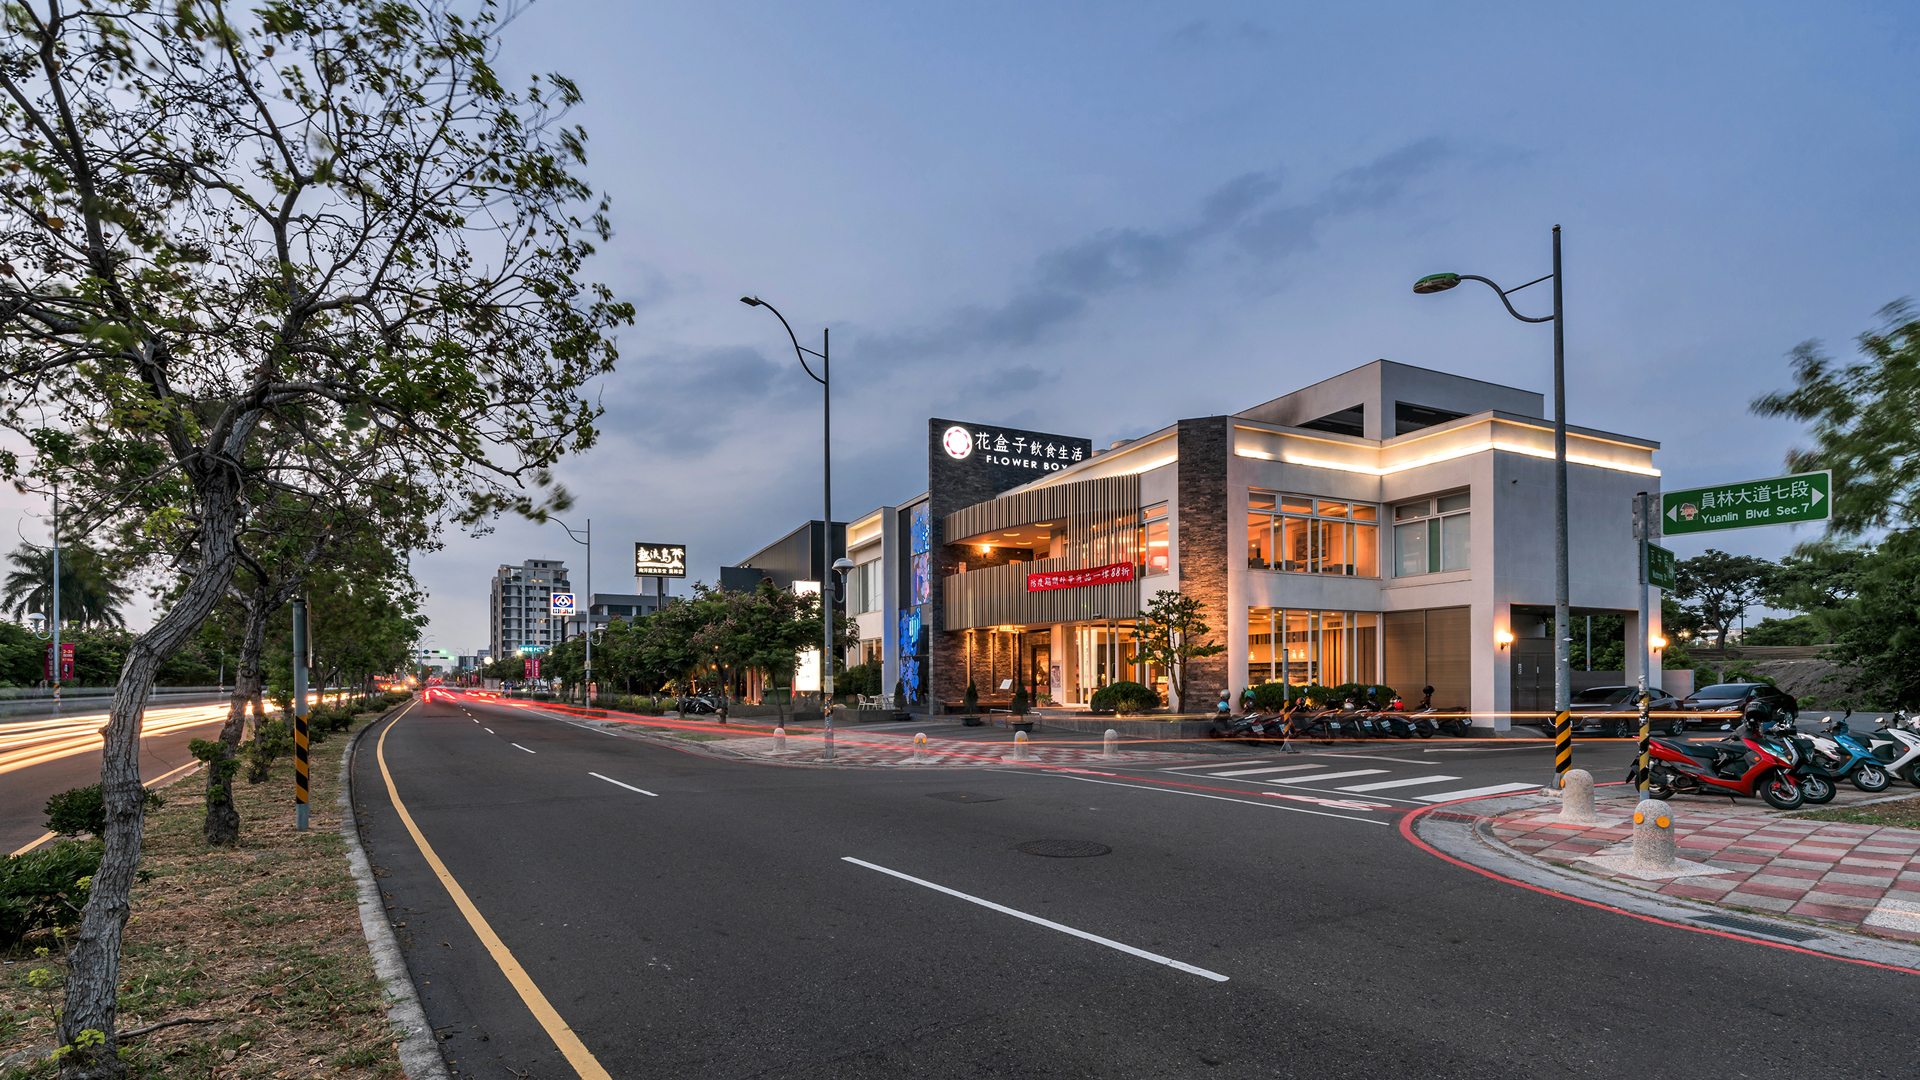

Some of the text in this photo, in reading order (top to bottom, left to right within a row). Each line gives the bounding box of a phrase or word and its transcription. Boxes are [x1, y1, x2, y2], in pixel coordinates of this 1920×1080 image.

[974, 432, 1083, 461] 花盒子飲食生活
[986, 454, 1037, 469] FLOWER
[1701, 480, 1809, 510] 員林大道七段
[1702, 503, 1810, 524] Yuanlin Blvd. Sec. 7
